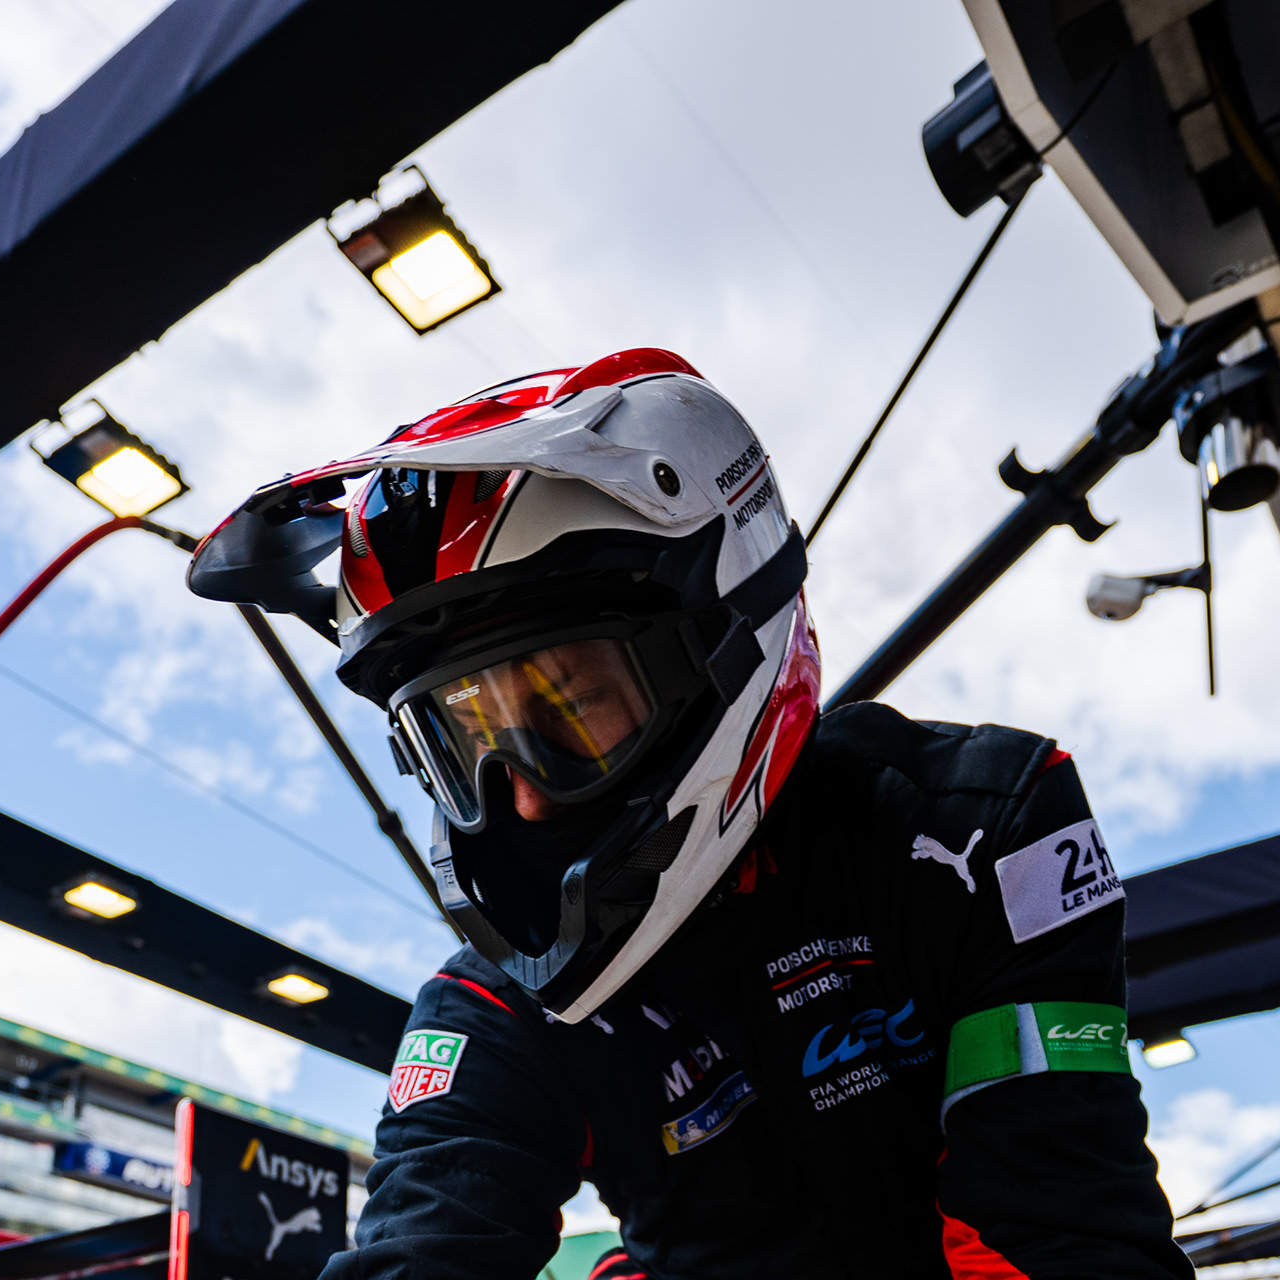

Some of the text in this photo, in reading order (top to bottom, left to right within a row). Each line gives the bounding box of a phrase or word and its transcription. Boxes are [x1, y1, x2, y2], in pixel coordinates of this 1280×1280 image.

[715, 452, 754, 495] PORSCHE
[446, 685, 480, 705] ESS
[1062, 876, 1122, 912] LE MANS
[1047, 1023, 1114, 1041] WEC
[401, 1036, 457, 1064] TAG
[809, 1082, 836, 1100] FIA
[240, 1137, 340, 1198] Ansys
